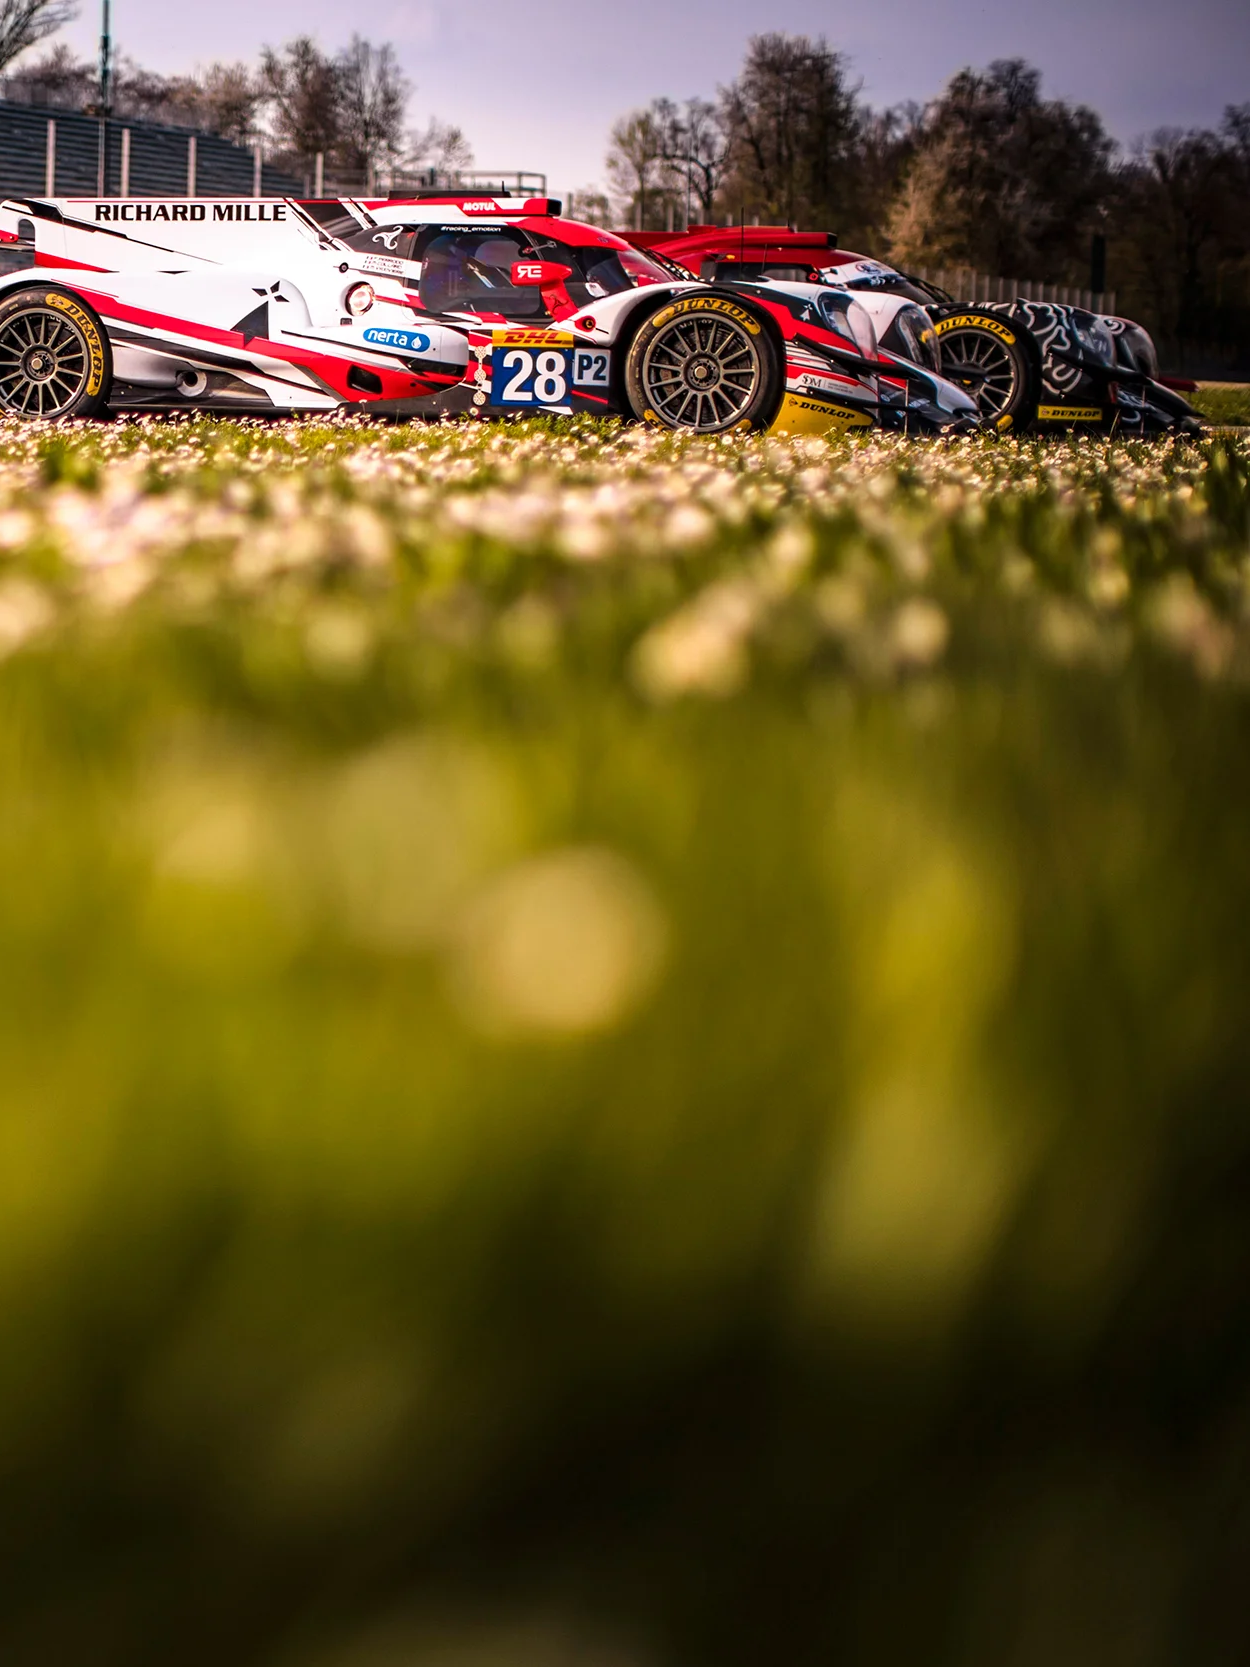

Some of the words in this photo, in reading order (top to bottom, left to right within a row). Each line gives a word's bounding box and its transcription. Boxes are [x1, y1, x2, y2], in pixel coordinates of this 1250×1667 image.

[95, 204, 206, 221] RICHARD
[212, 204, 287, 221] MILLE
[462, 202, 496, 211] MOTUL
[440, 225, 501, 233] #racing_emotion
[673, 298, 756, 326] DUNLOP
[940, 315, 1012, 338] DUNLOP
[64, 303, 103, 388] DUNLOP
[367, 330, 409, 347] nerta
[503, 331, 564, 344] DHL
[502, 350, 567, 403] 28
[577, 354, 608, 382] P2
[799, 401, 856, 420] DUNLOP
[1051, 409, 1101, 418] DUNLOP
